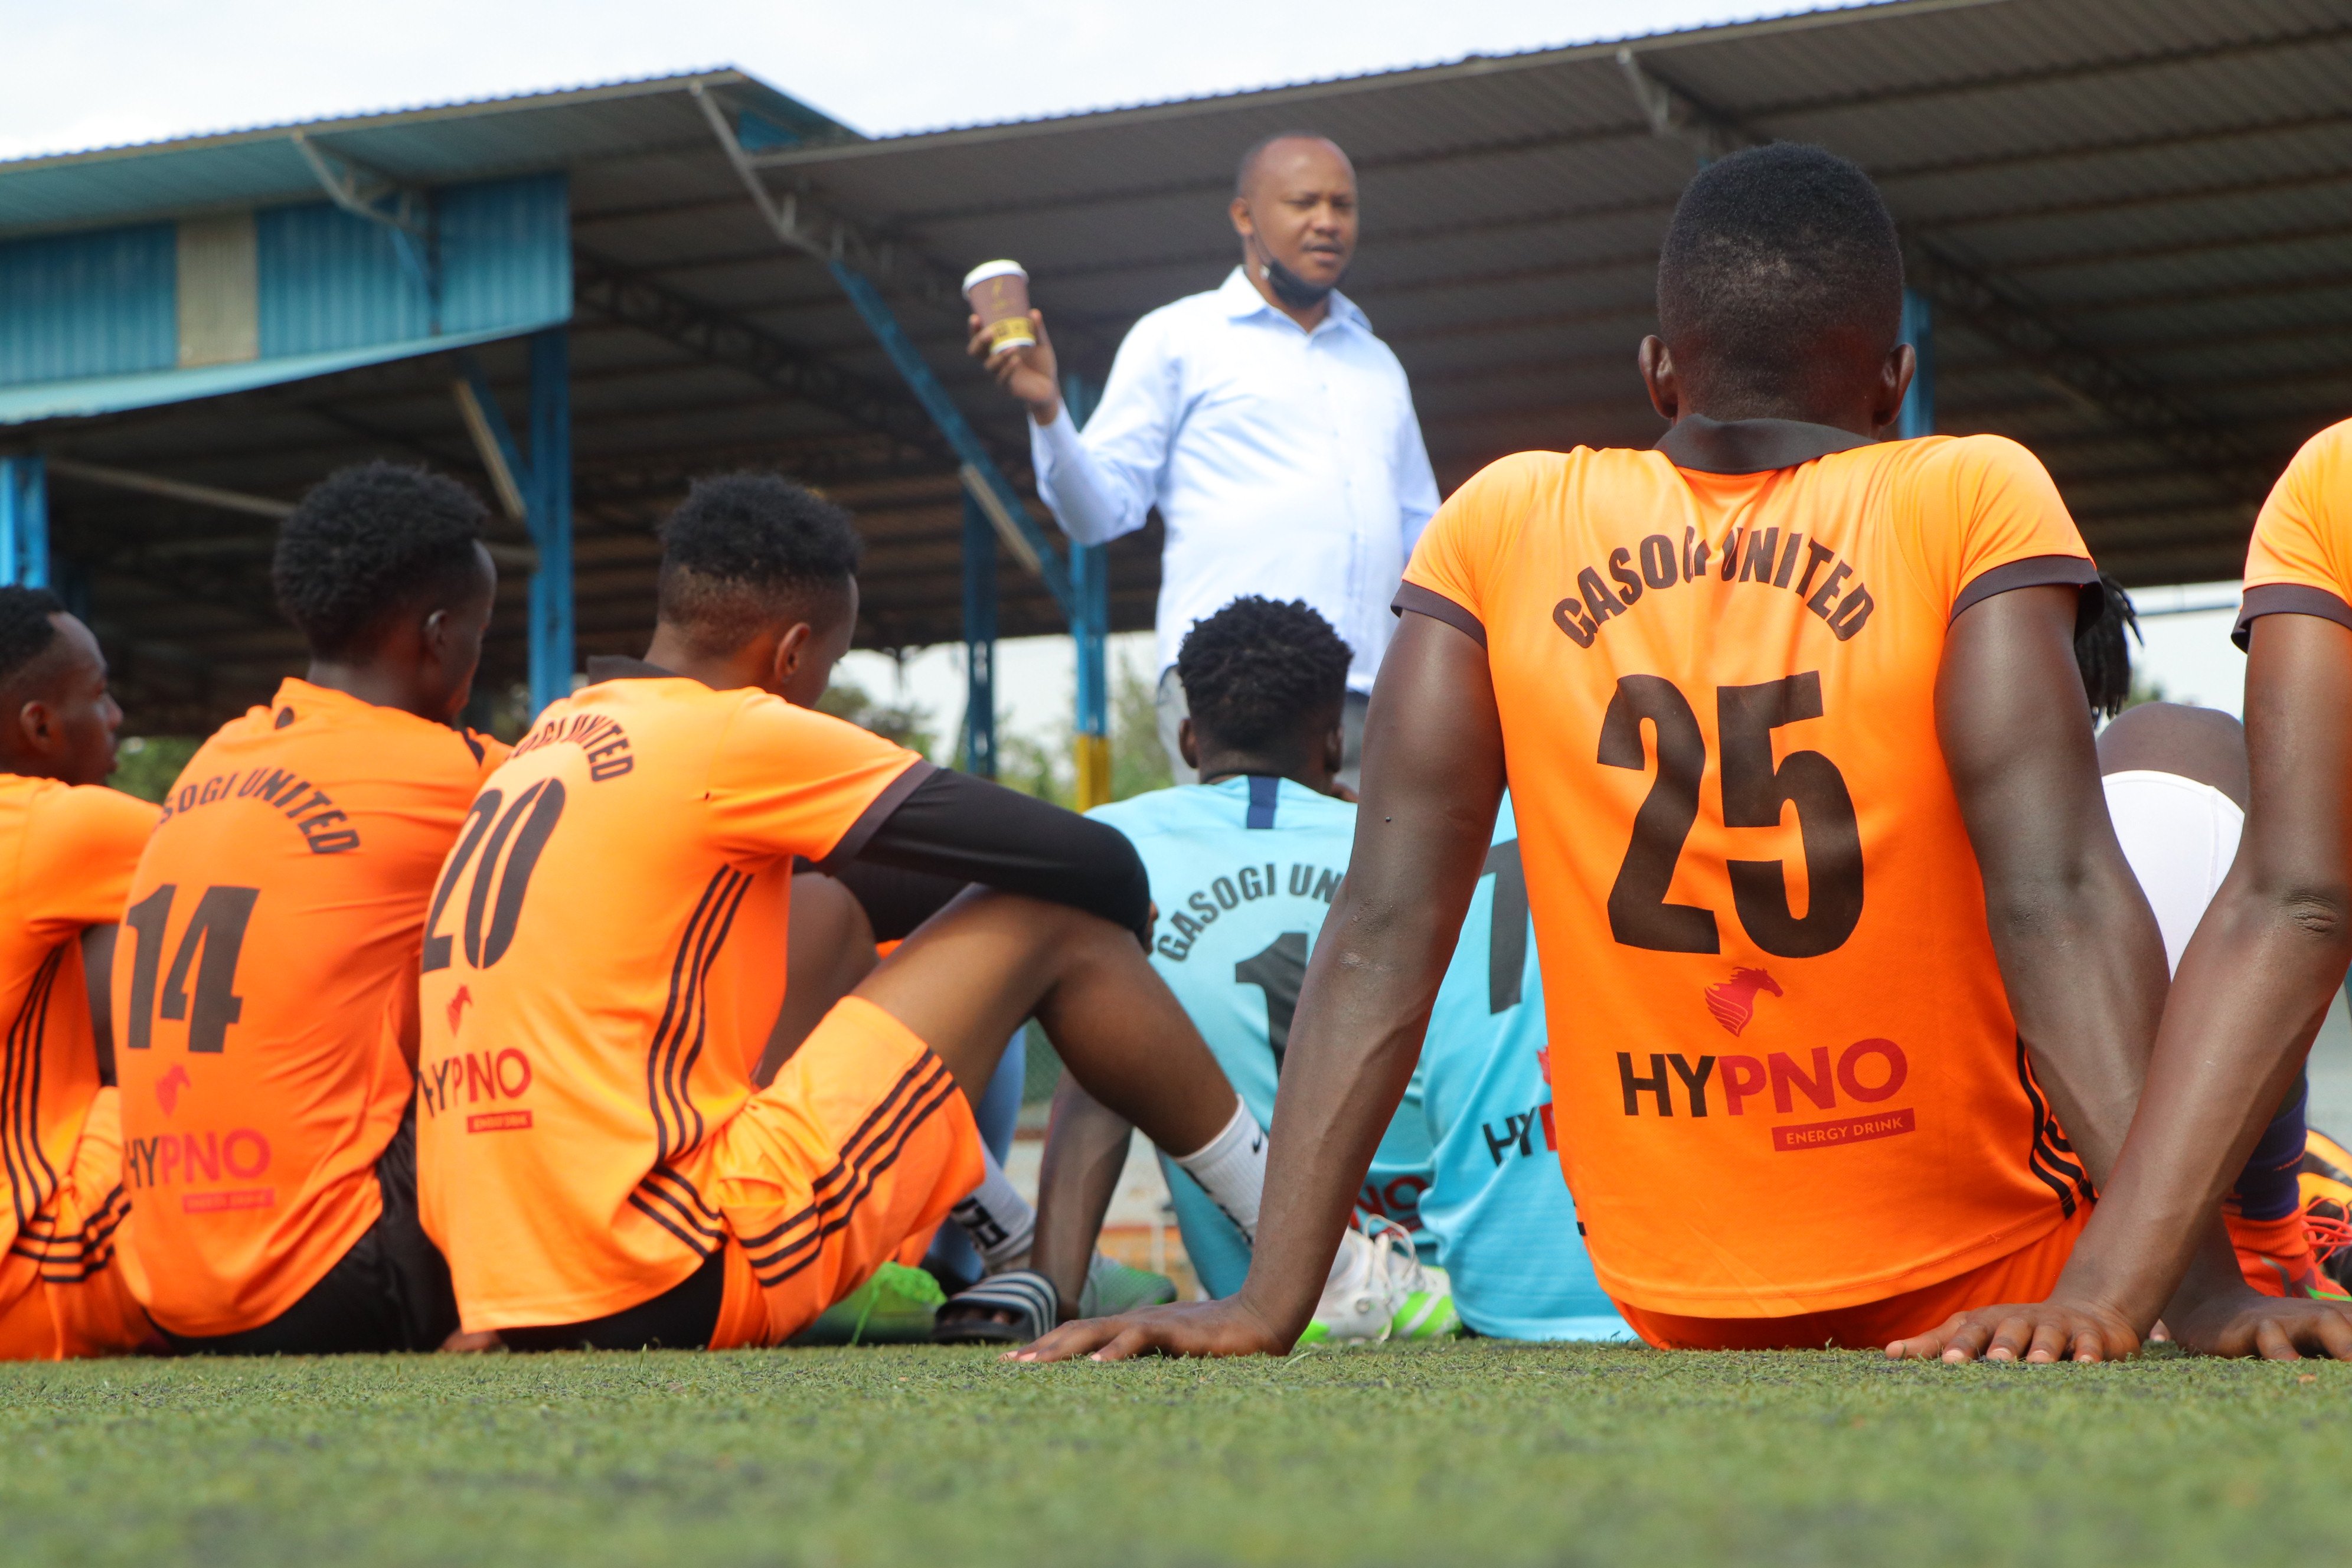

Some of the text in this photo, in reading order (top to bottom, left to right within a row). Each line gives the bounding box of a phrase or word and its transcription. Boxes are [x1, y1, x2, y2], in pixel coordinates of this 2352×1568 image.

[1721, 527, 1874, 641] UNITED
[237, 768, 360, 854] UNITED
[1597, 671, 1864, 958] 25
[422, 776, 566, 978] 20
[1157, 864, 1275, 963] GASOGI
[126, 884, 260, 1053] 14
[1616, 1038, 1908, 1118] HYPNO
[1786, 1117, 1903, 1145] ENERGY DRINK
